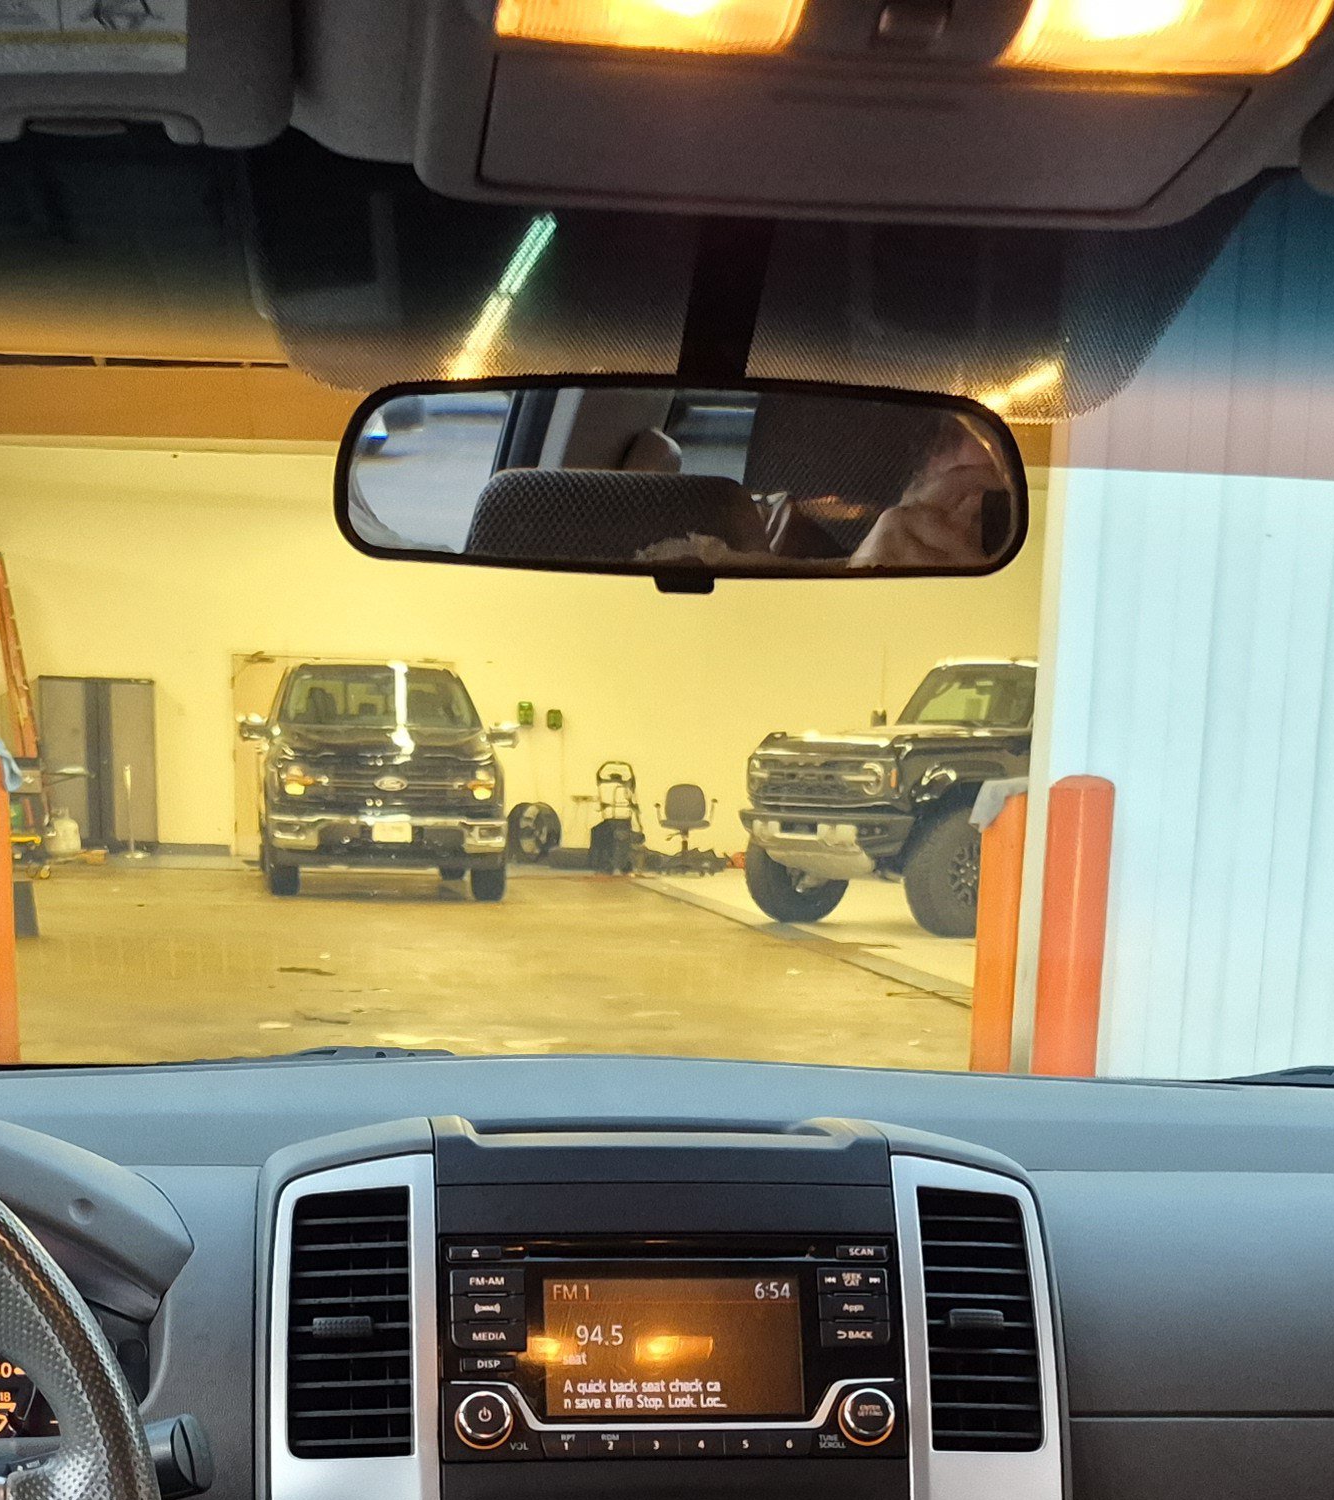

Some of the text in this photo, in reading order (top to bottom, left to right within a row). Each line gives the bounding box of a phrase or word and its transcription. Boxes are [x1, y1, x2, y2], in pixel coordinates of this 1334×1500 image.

[849, 1248, 874, 1256] SCAN
[553, 1284, 591, 1300] FM 1
[754, 1282, 791, 1300] 6:54
[843, 1303, 864, 1313] Apps
[472, 1332, 506, 1341] MEDIA
[576, 1325, 624, 1346] 94.5
[848, 1331, 873, 1339] BACK
[477, 1360, 501, 1369] DISP
[563, 1379, 721, 1395] A quick back seat check ca
[0, 1391, 11, 1403] 18
[564, 1399, 572, 1409] n
[574, 1398, 601, 1410] save
[604, 1398, 613, 1409] a
[615, 1395, 633, 1409] life
[561, 1434, 576, 1442] RPT
[510, 1442, 529, 1451] VOL
[607, 1442, 614, 1450] 2
[653, 1441, 661, 1450] 3
[697, 1440, 705, 1450] 4
[742, 1440, 750, 1449] 5
[785, 1439, 794, 1449] 6
